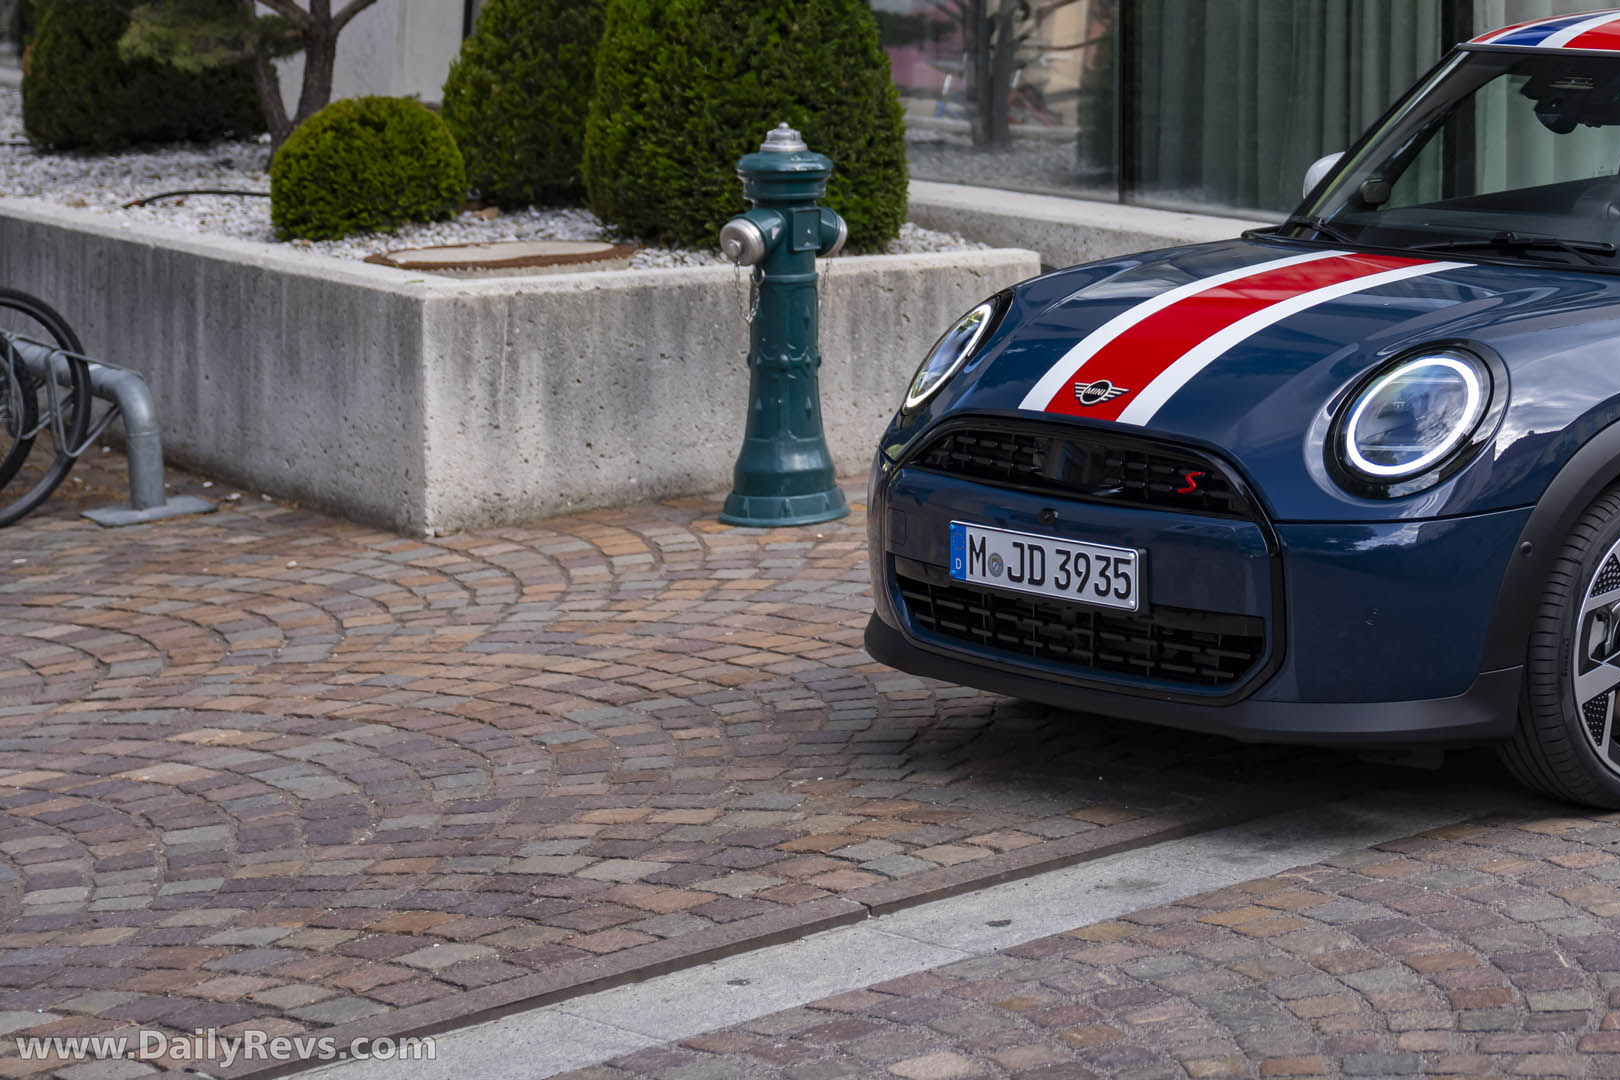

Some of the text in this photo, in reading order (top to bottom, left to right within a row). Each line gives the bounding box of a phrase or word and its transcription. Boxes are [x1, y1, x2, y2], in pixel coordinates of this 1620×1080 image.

[1085, 386, 1106, 396] MINI
[1176, 471, 1204, 494] S
[955, 558, 962, 570] D
[969, 534, 1132, 600] M JD 3935
